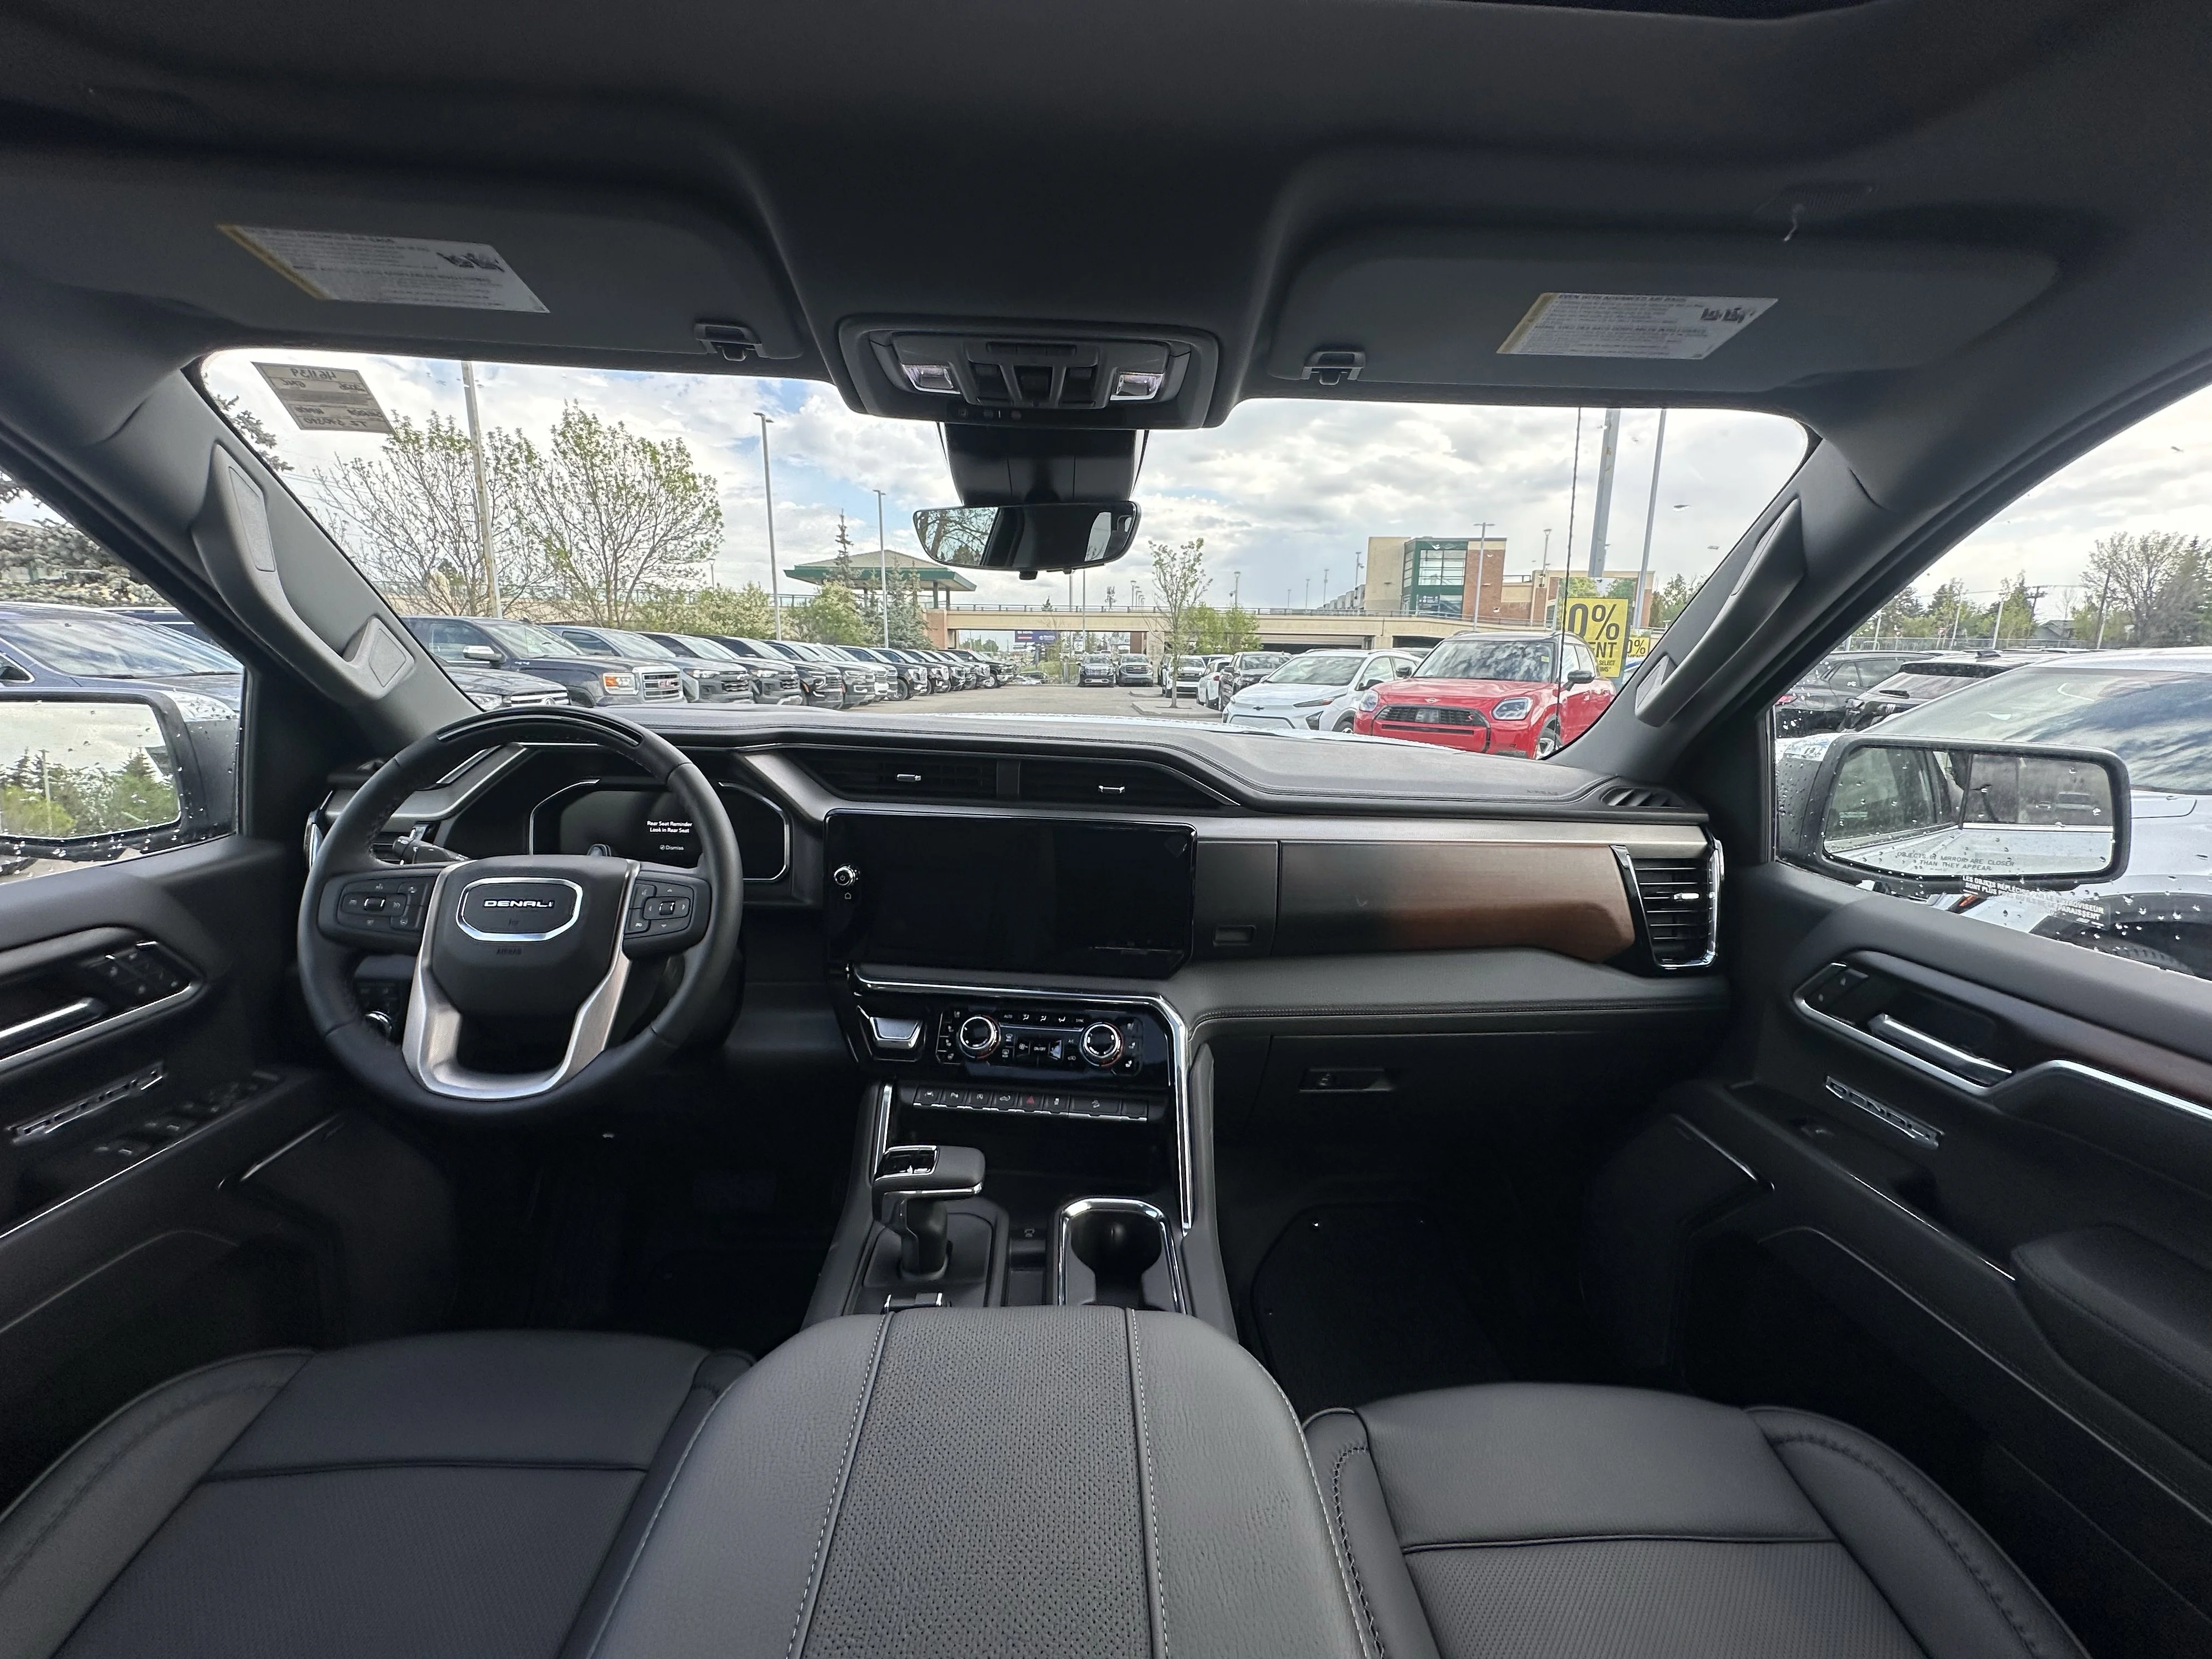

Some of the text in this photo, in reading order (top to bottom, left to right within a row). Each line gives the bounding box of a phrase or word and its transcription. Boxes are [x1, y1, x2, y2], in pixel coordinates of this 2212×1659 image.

[1897, 851, 1926, 860] OBJECTS
[1965, 882, 1981, 891] SONT
[1982, 885, 1997, 895] PLUS
[1974, 878, 1996, 888] OBJETS
[1825, 1076, 1939, 1149] DENALI
